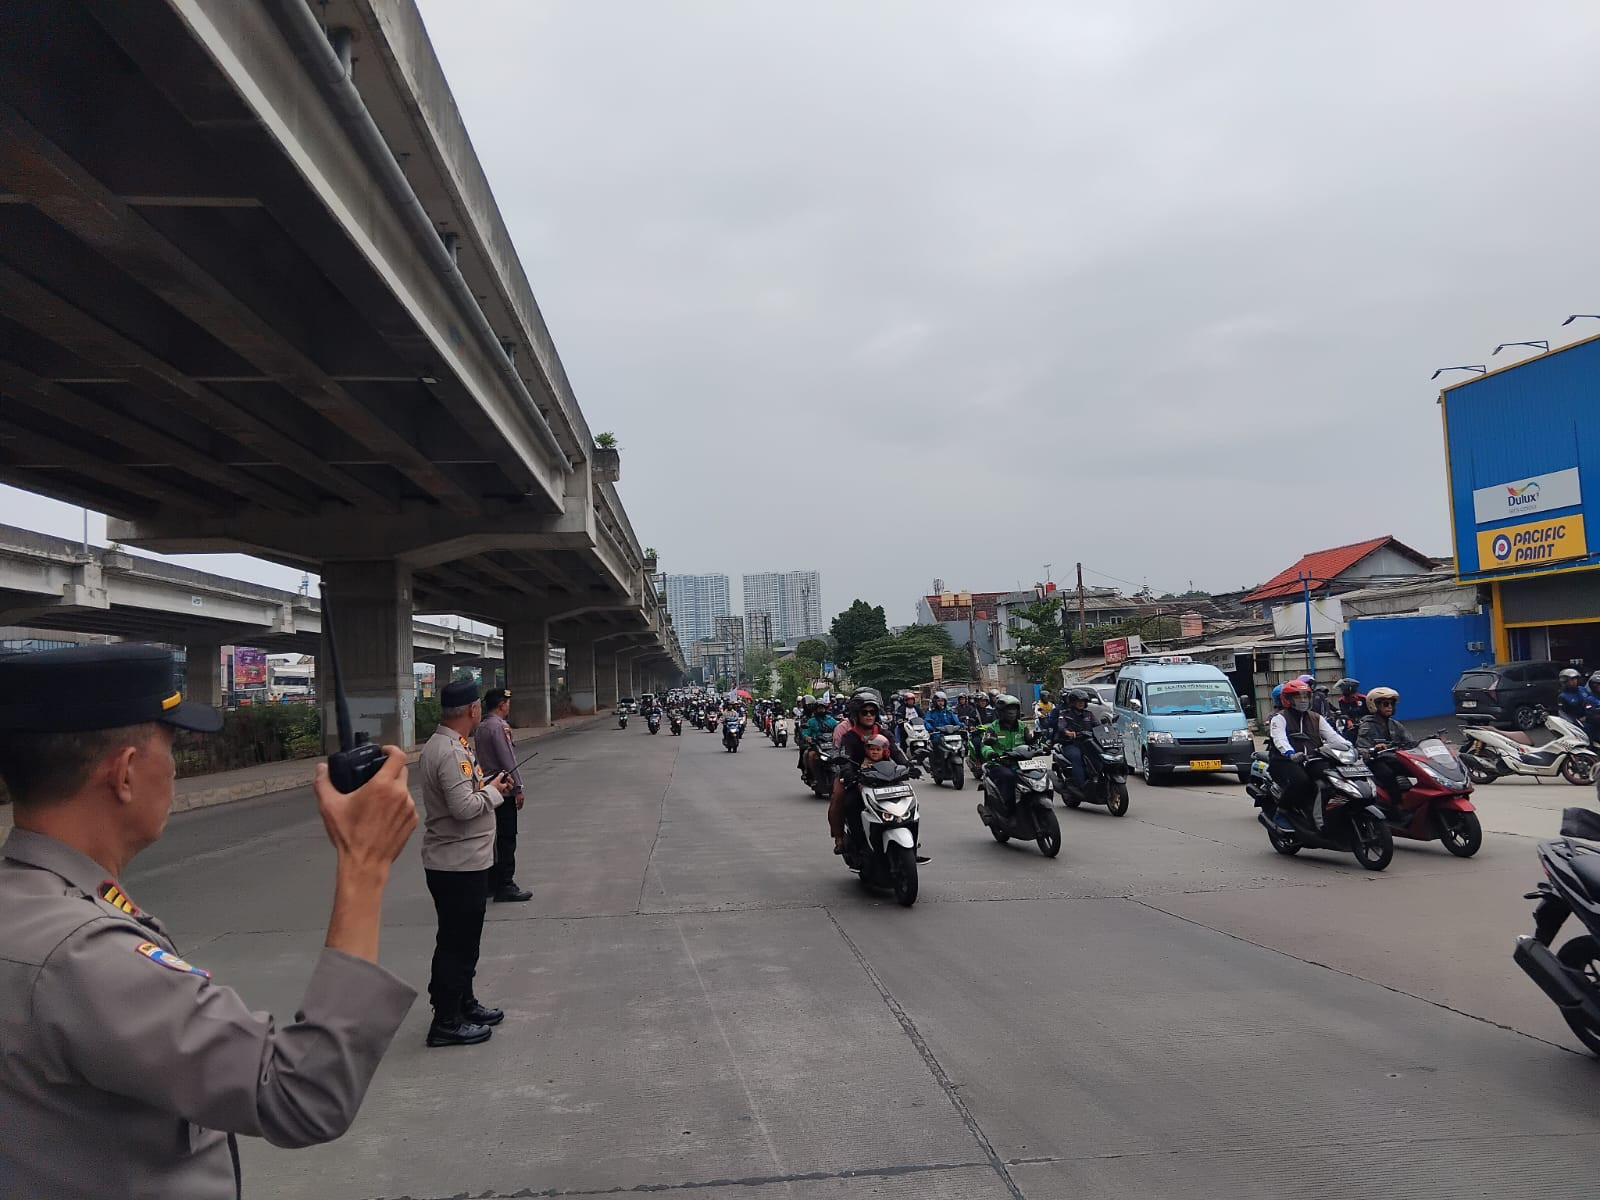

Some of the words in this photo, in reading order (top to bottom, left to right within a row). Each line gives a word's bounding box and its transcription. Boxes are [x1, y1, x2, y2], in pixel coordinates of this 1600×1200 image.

[1507, 495, 1537, 506] Dulux
[1513, 525, 1566, 546] PACIFIC
[1515, 544, 1555, 562] PAINT
